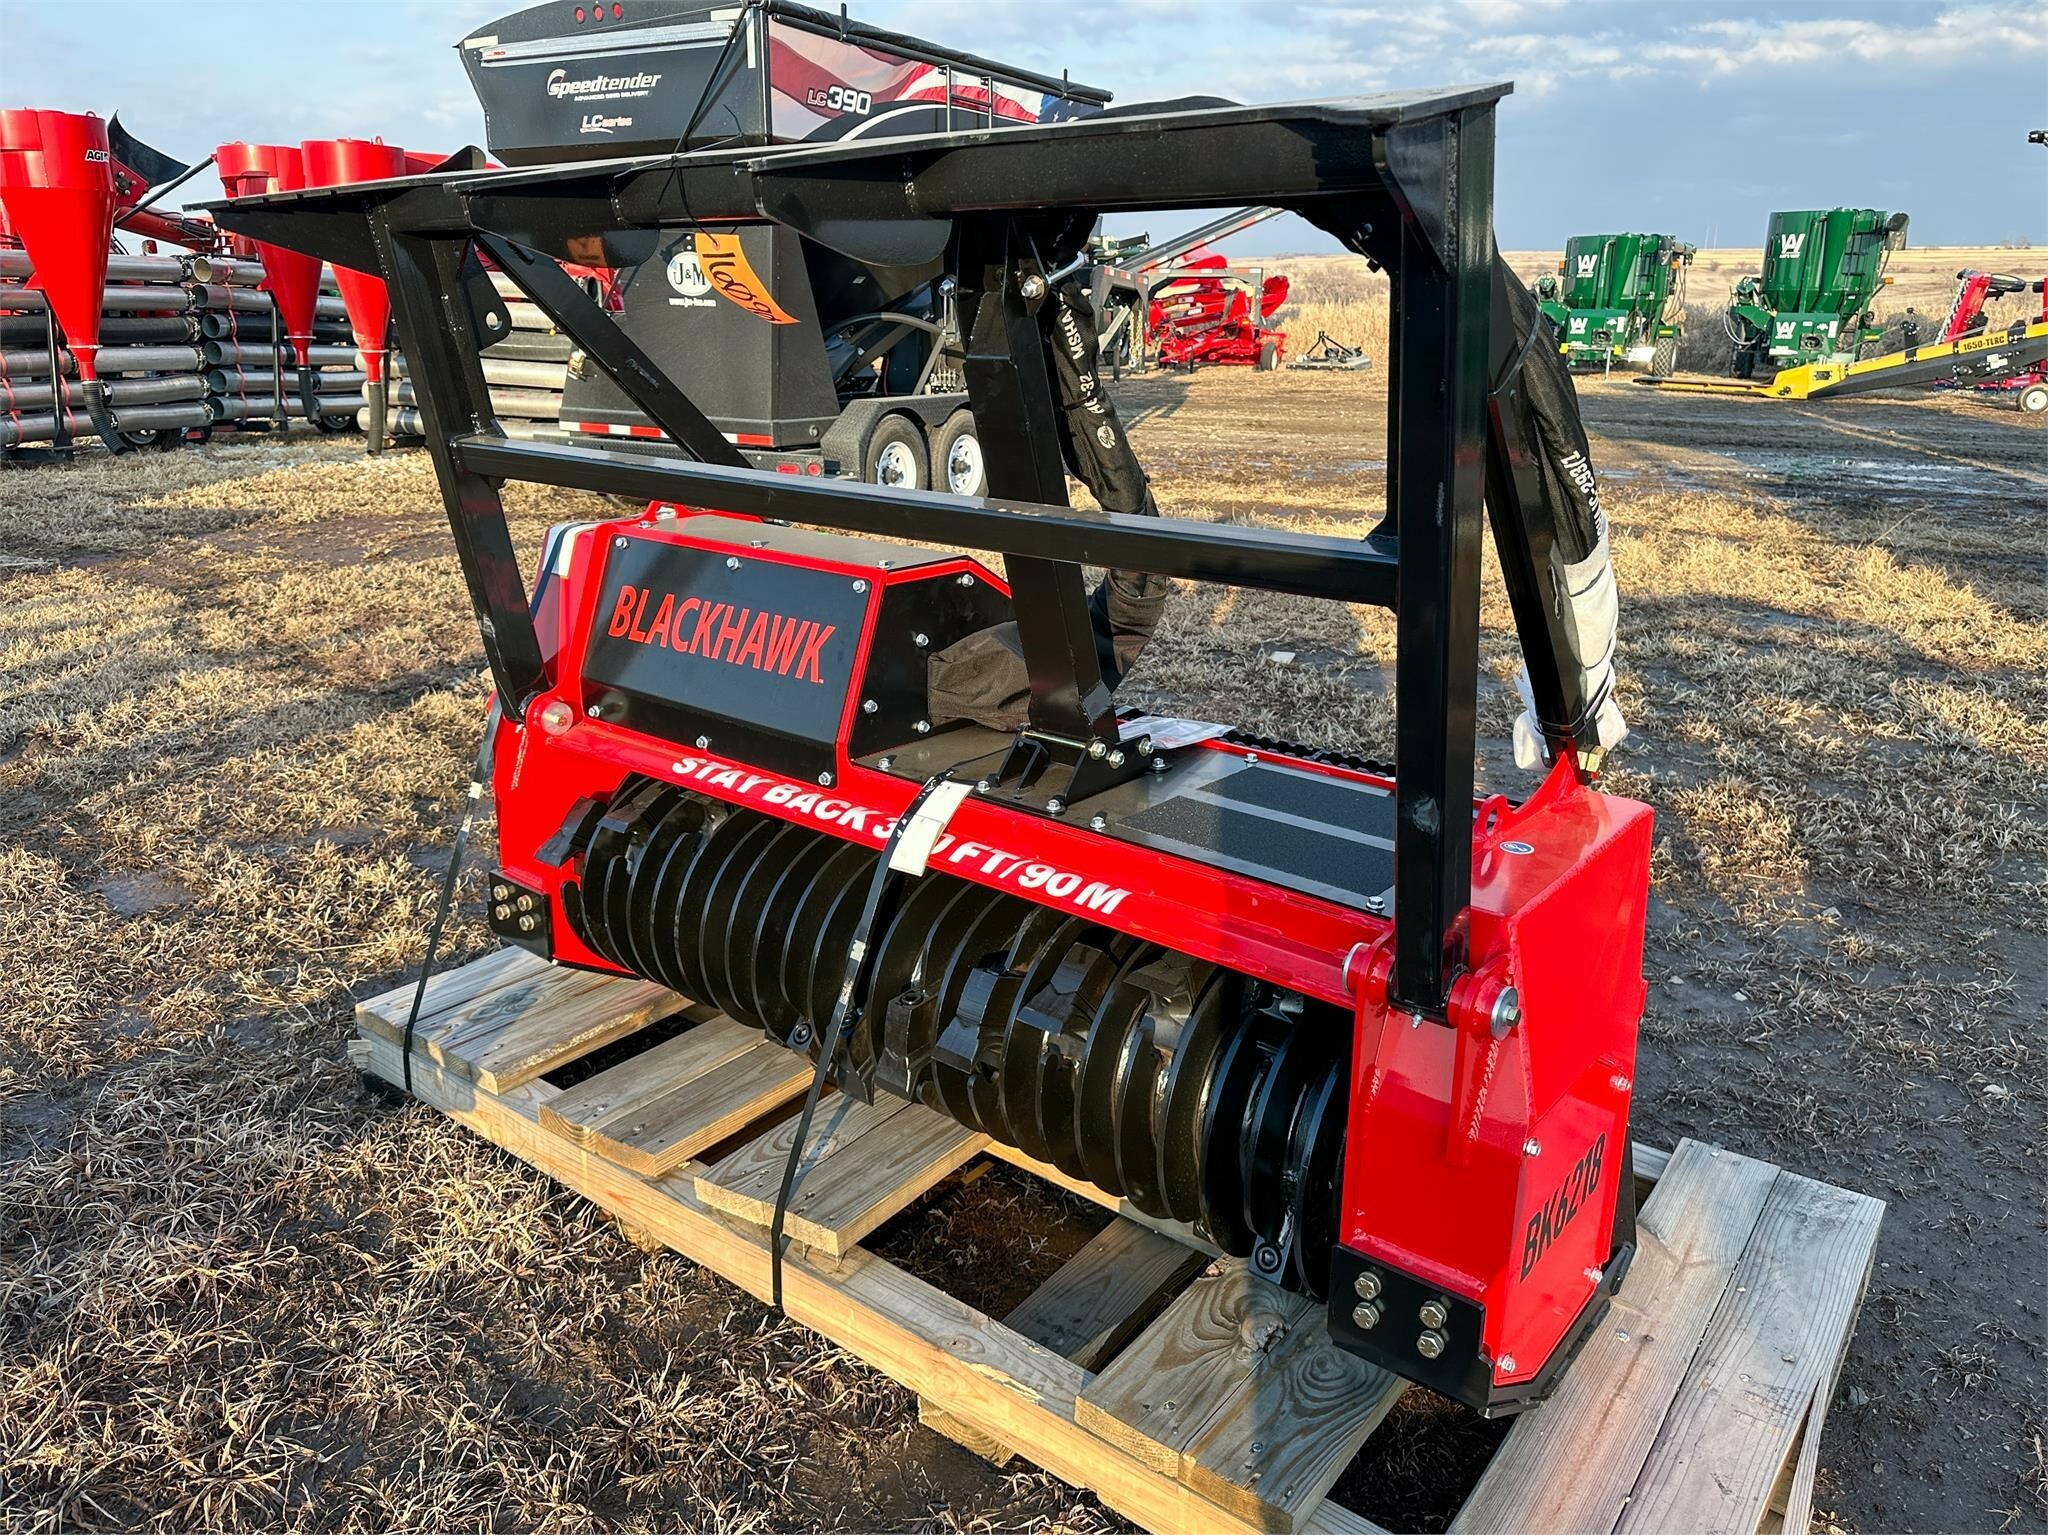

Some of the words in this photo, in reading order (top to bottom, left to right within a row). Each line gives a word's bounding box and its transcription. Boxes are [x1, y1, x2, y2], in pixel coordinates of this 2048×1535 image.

[86, 150, 104, 161] AGI
[1061, 309, 1085, 360] MSHA
[1963, 336, 2005, 351] 1650-TLRC
[607, 585, 836, 684] BLACKHAWK
[671, 757, 777, 794] STAY
[761, 783, 884, 832] BACK
[872, 816, 956, 855] 30
[948, 841, 1084, 898] FT/90
[1073, 881, 1133, 915] M
[1520, 1132, 1606, 1284] BK6218
